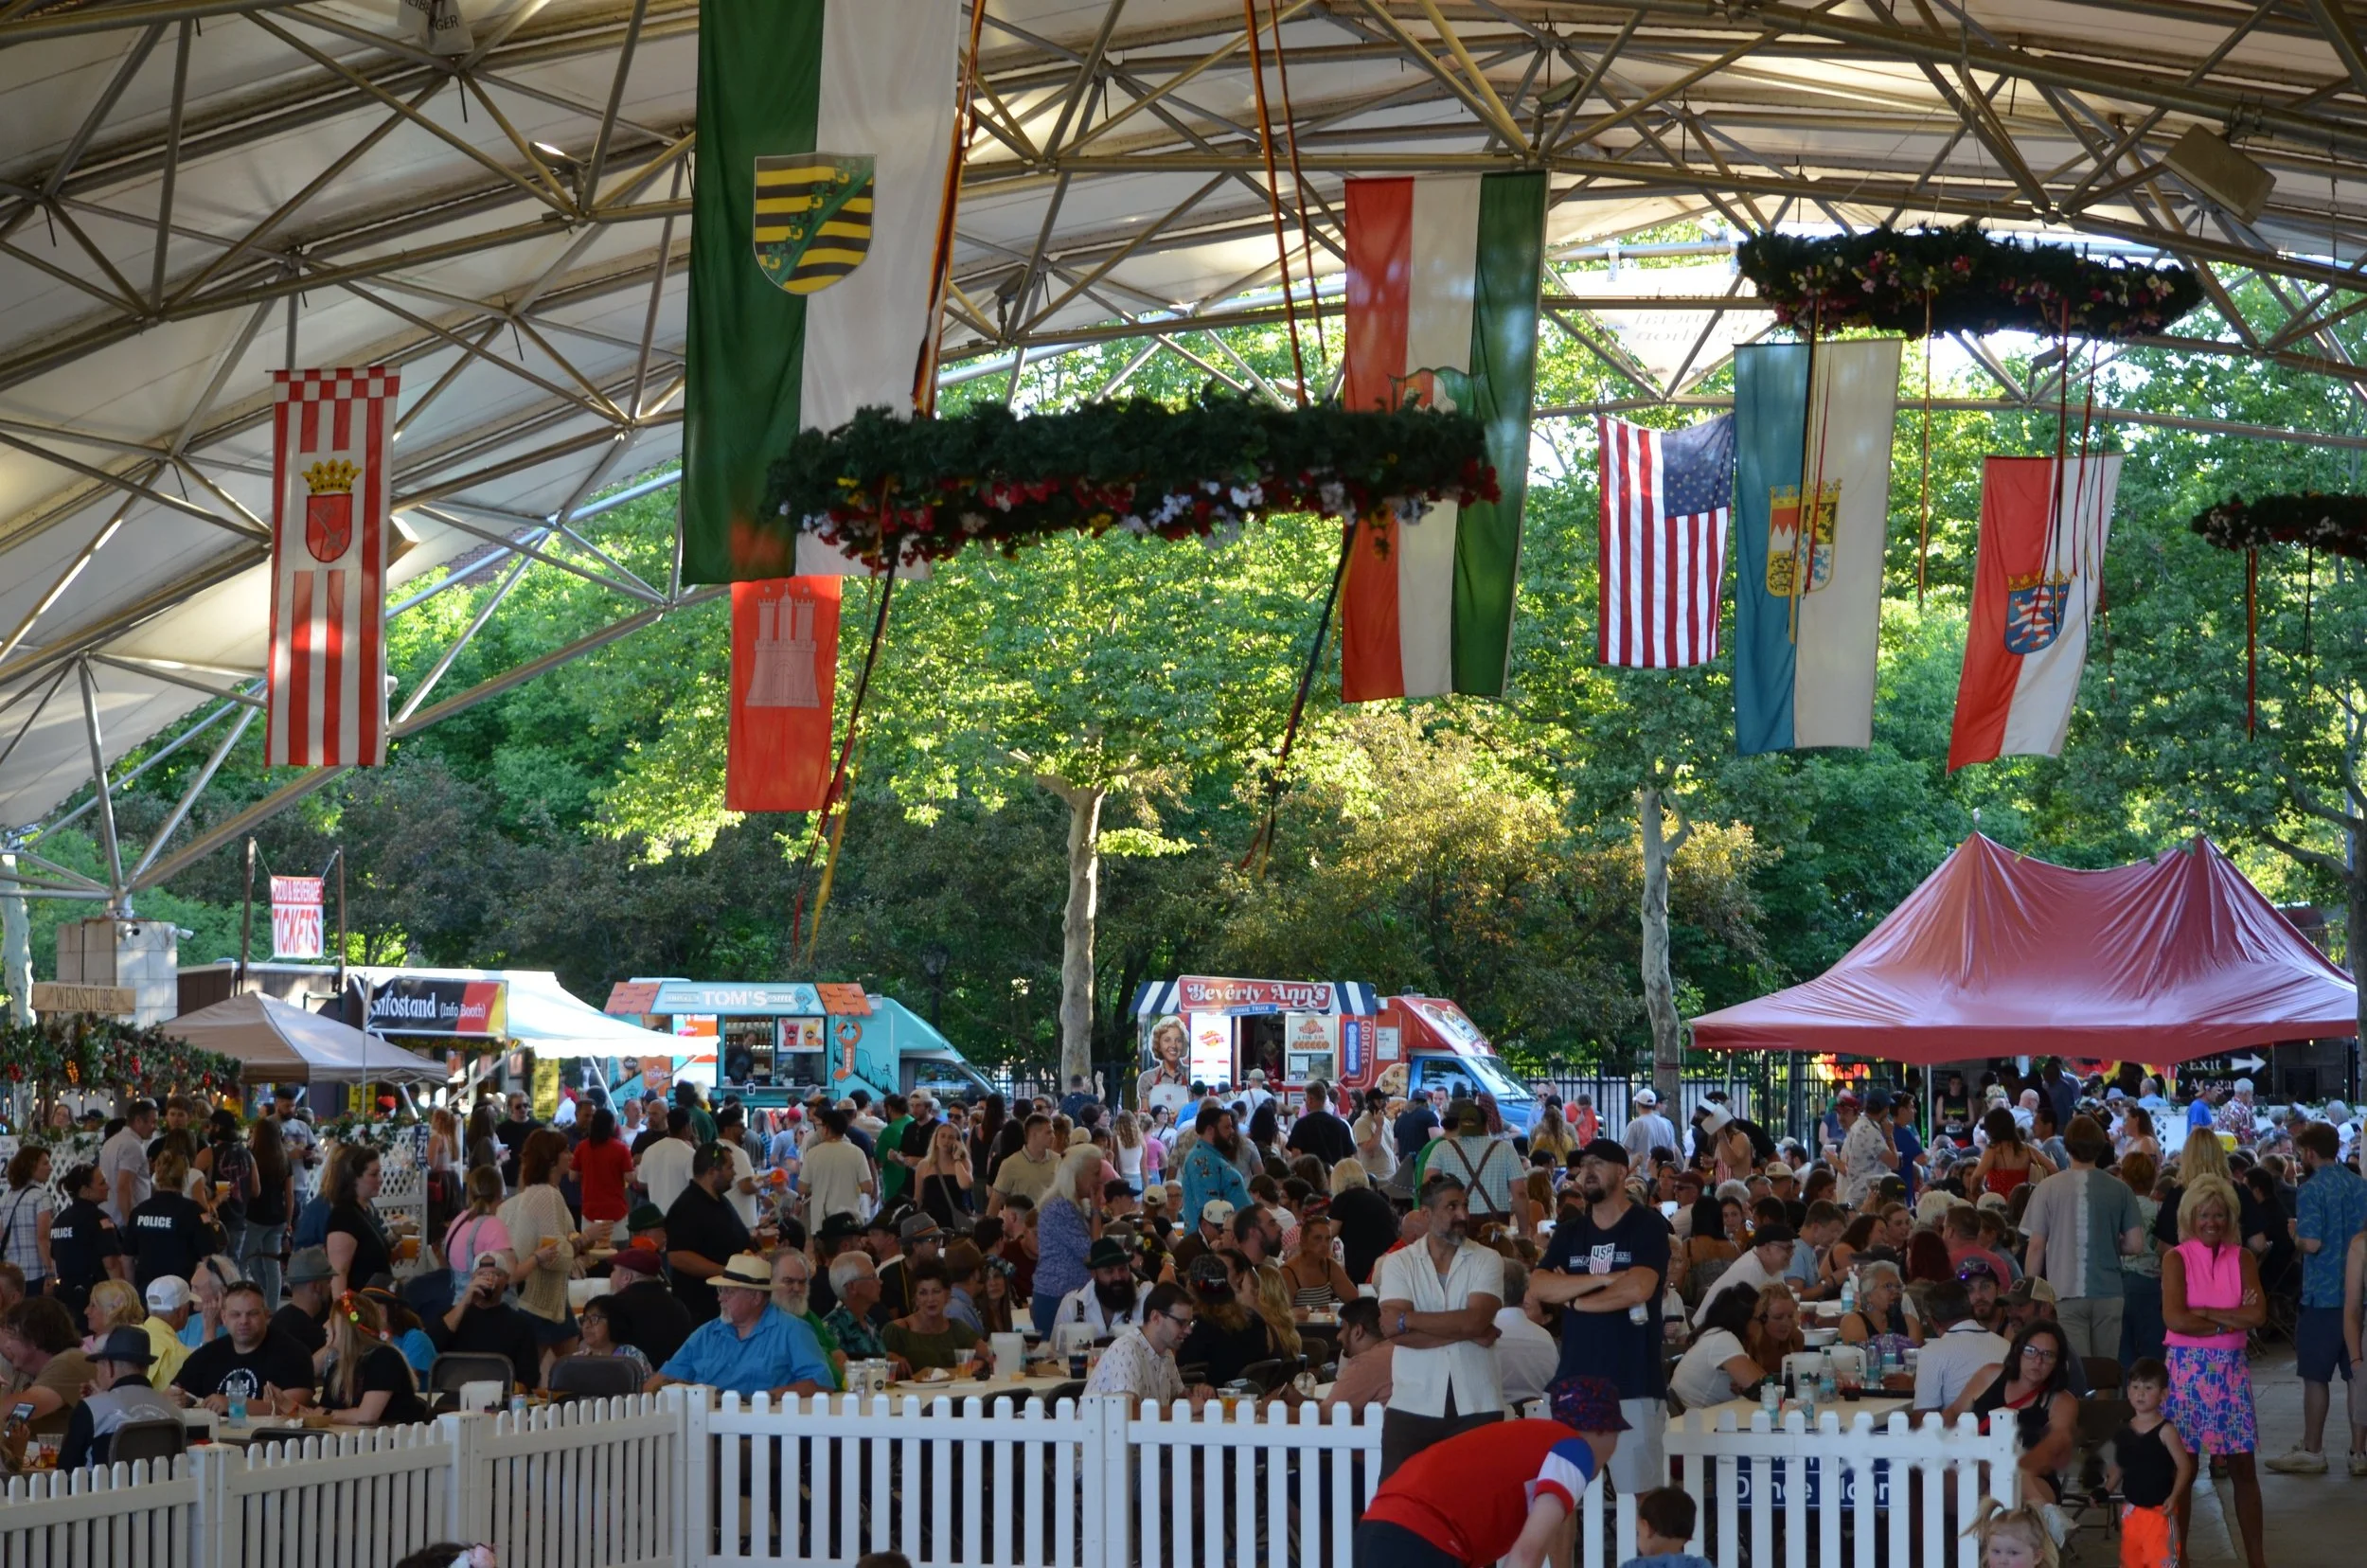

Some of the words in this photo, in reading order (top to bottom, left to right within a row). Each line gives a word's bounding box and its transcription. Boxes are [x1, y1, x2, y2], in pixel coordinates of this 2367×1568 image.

[273, 908, 319, 954] TICKETS
[56, 987, 115, 1011] WEINSTUBE
[703, 989, 768, 1007] TOM'S
[1187, 983, 1264, 1005] Beverly
[1271, 983, 1326, 1008] Ann's
[440, 1003, 459, 1019] (Info
[460, 1003, 486, 1019] Booth)
[1252, 1005, 1270, 1013] TRUCK
[1361, 1021, 1371, 1064] COOKIES
[2189, 1059, 2221, 1071] Exit
[137, 1215, 172, 1228] POLICE
[50, 1227, 73, 1239] POLICE
[1736, 1475, 1813, 1500] Dne
